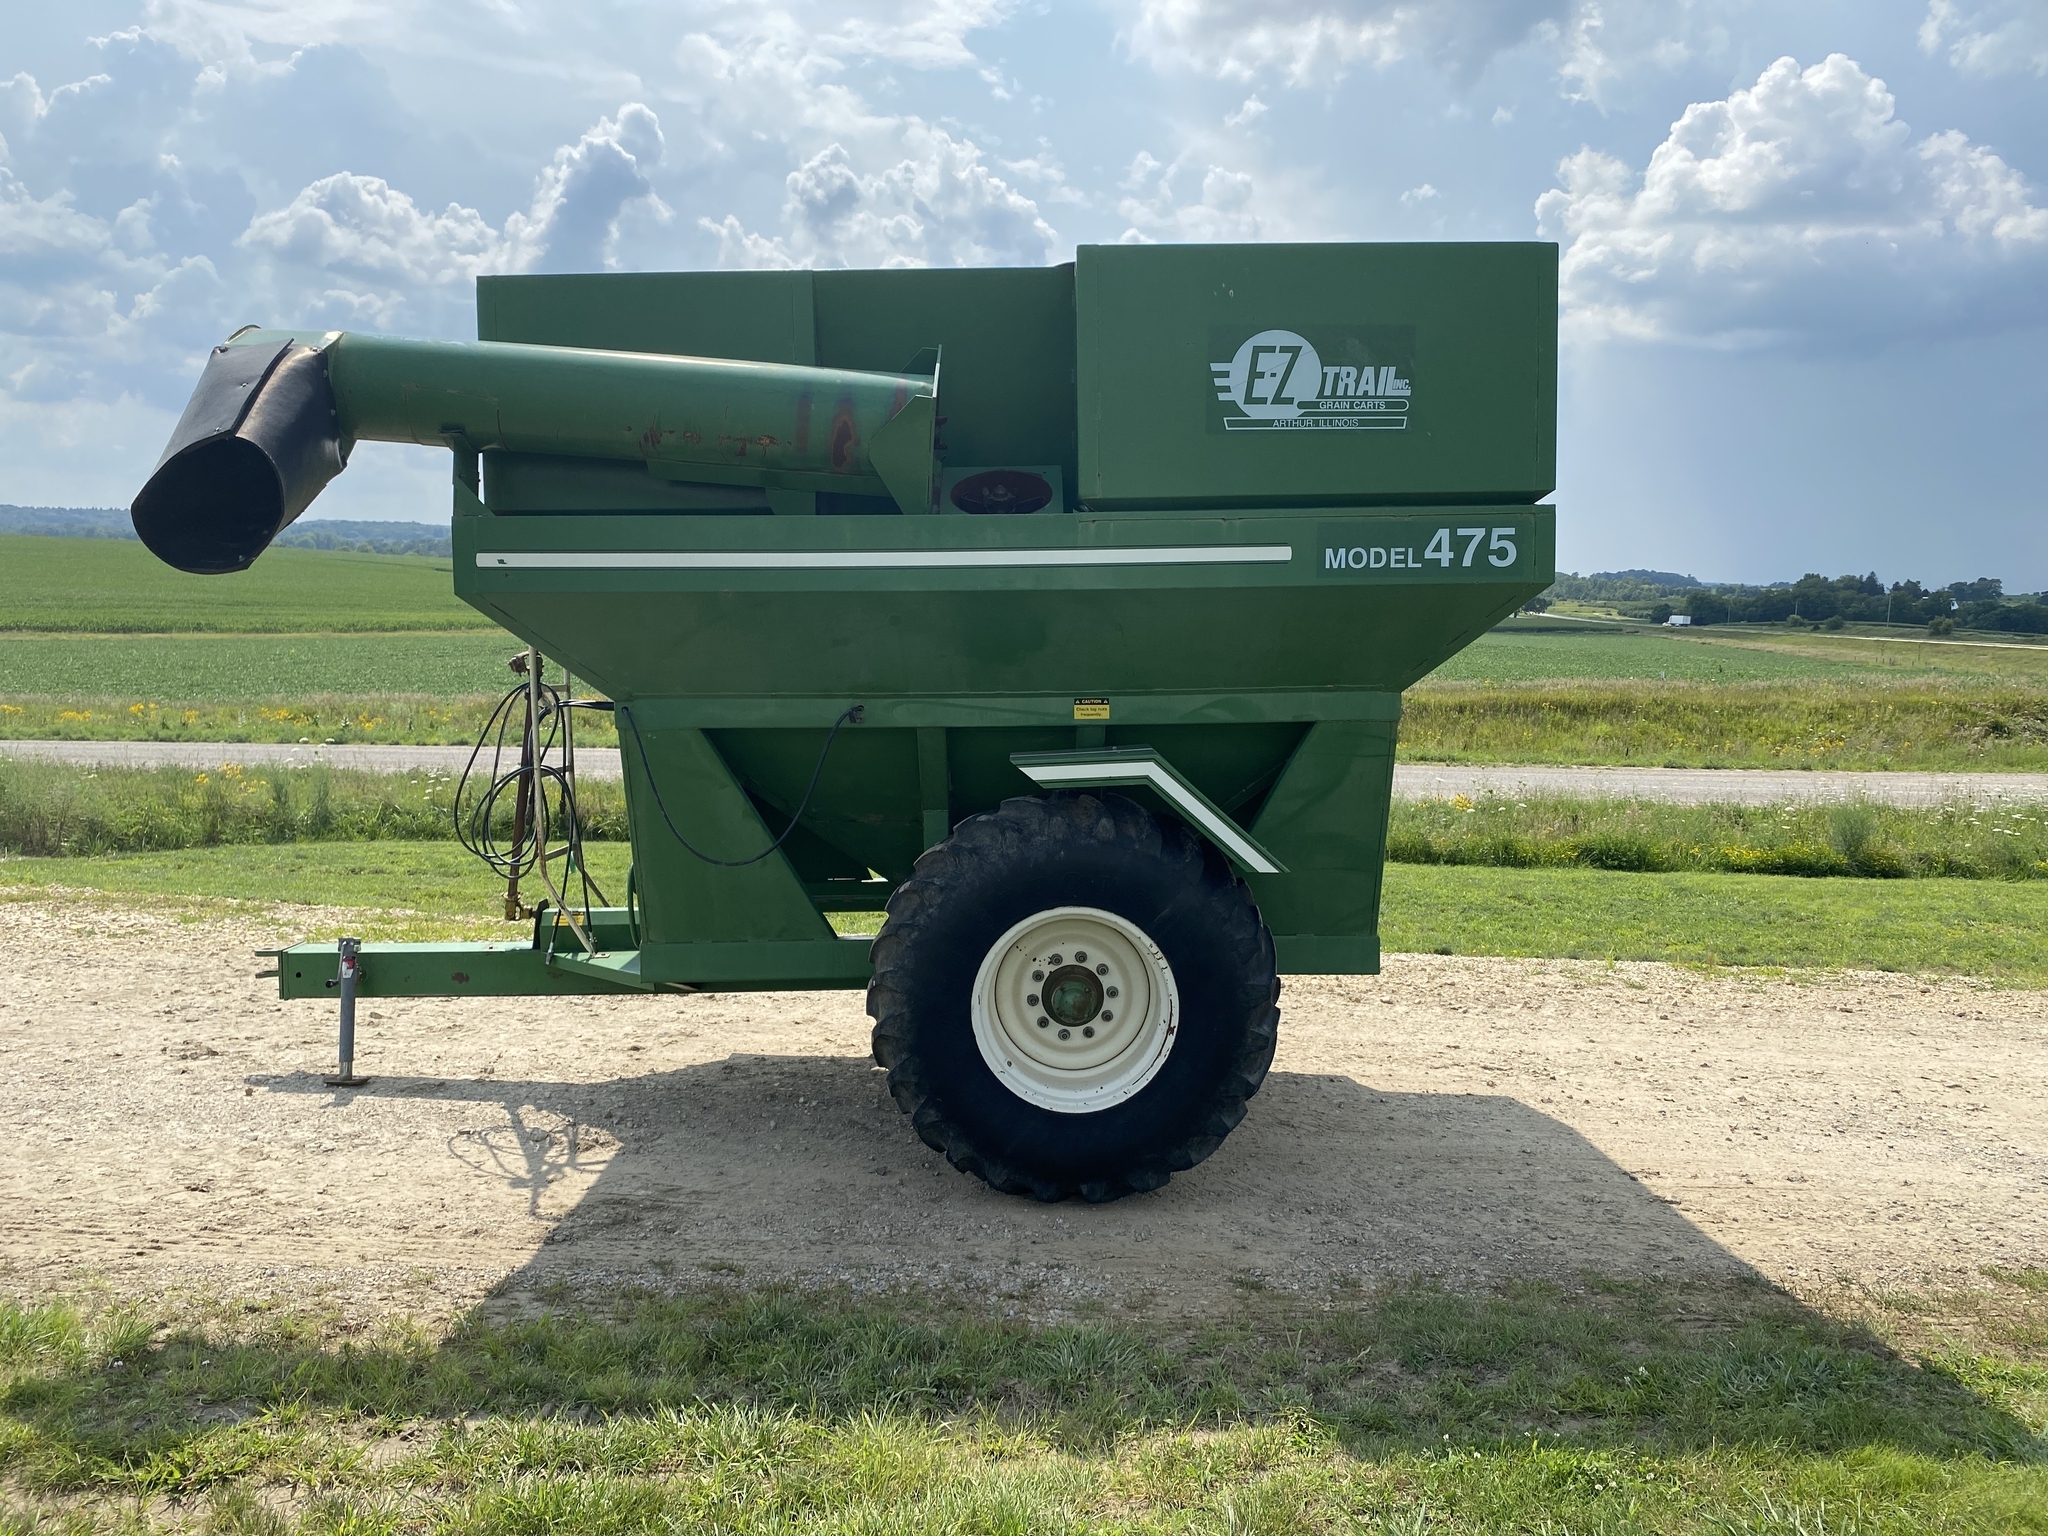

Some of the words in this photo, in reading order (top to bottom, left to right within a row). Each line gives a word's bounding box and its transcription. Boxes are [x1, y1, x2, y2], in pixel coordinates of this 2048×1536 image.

[1323, 366, 1411, 396] TRAIL
[1392, 379, 1411, 390] INC.
[1319, 400, 1350, 410] GRAIN
[1353, 400, 1386, 410] CARTS
[1318, 418, 1359, 428] ILLINOIS
[1325, 547, 1422, 569] MODEL
[1424, 527, 1517, 568] 475
